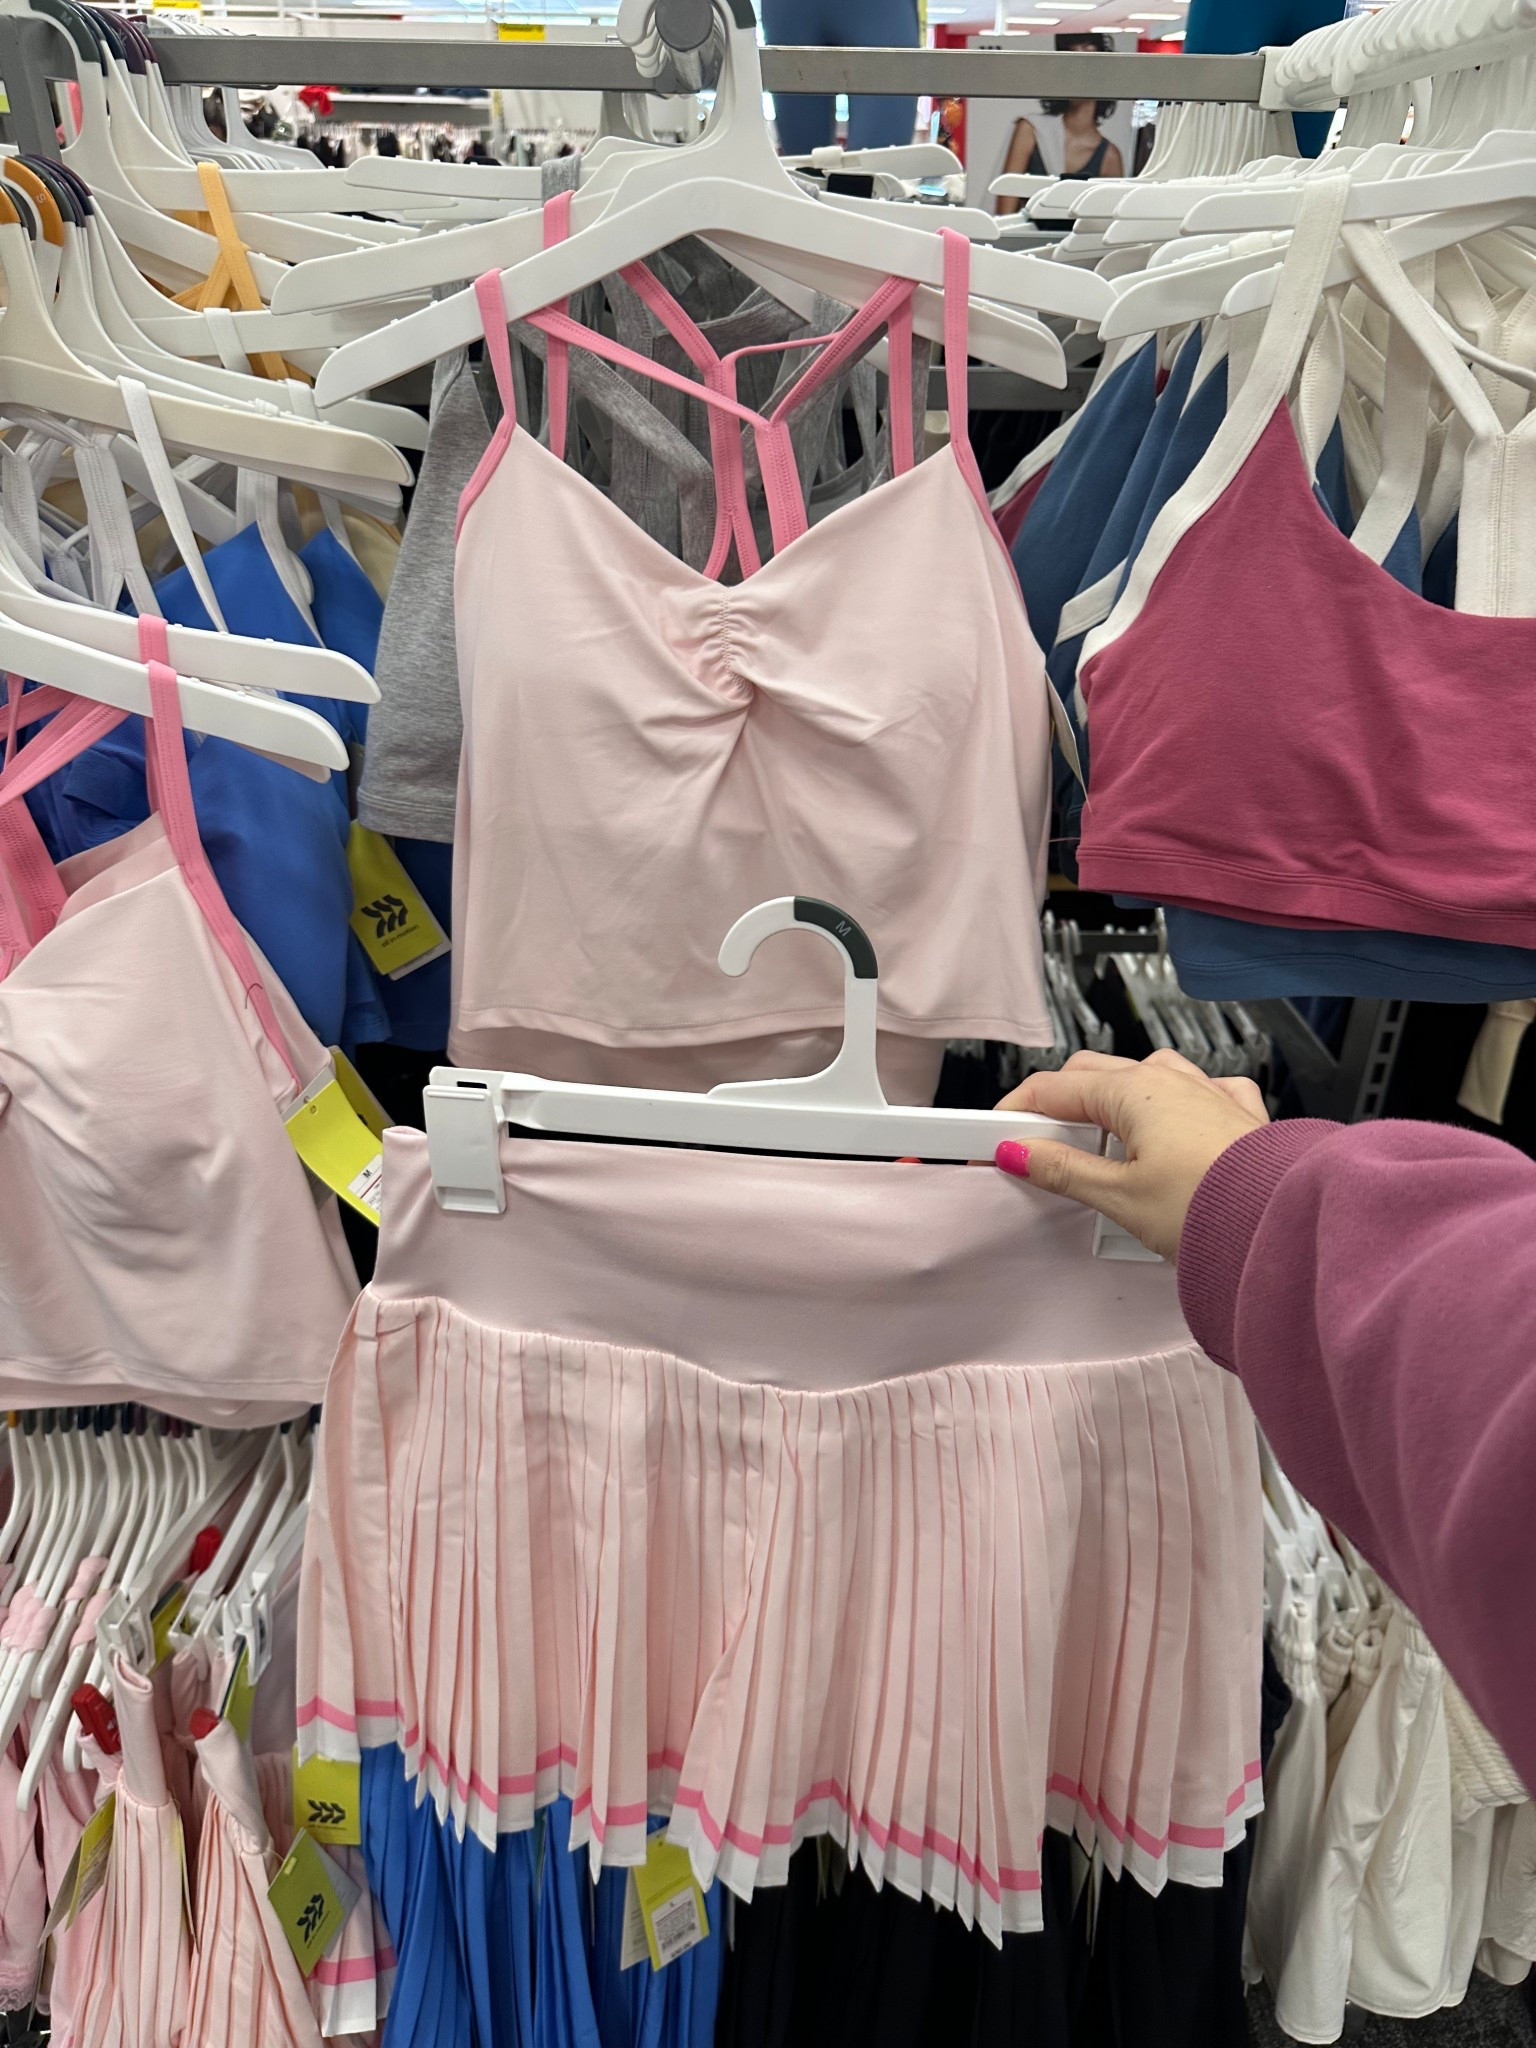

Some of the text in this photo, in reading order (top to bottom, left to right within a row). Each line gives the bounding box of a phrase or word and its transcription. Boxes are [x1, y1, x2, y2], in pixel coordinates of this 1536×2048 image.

[36, 193, 46, 204] S
[835, 920, 852, 937] M
[362, 1169, 373, 1179] M
